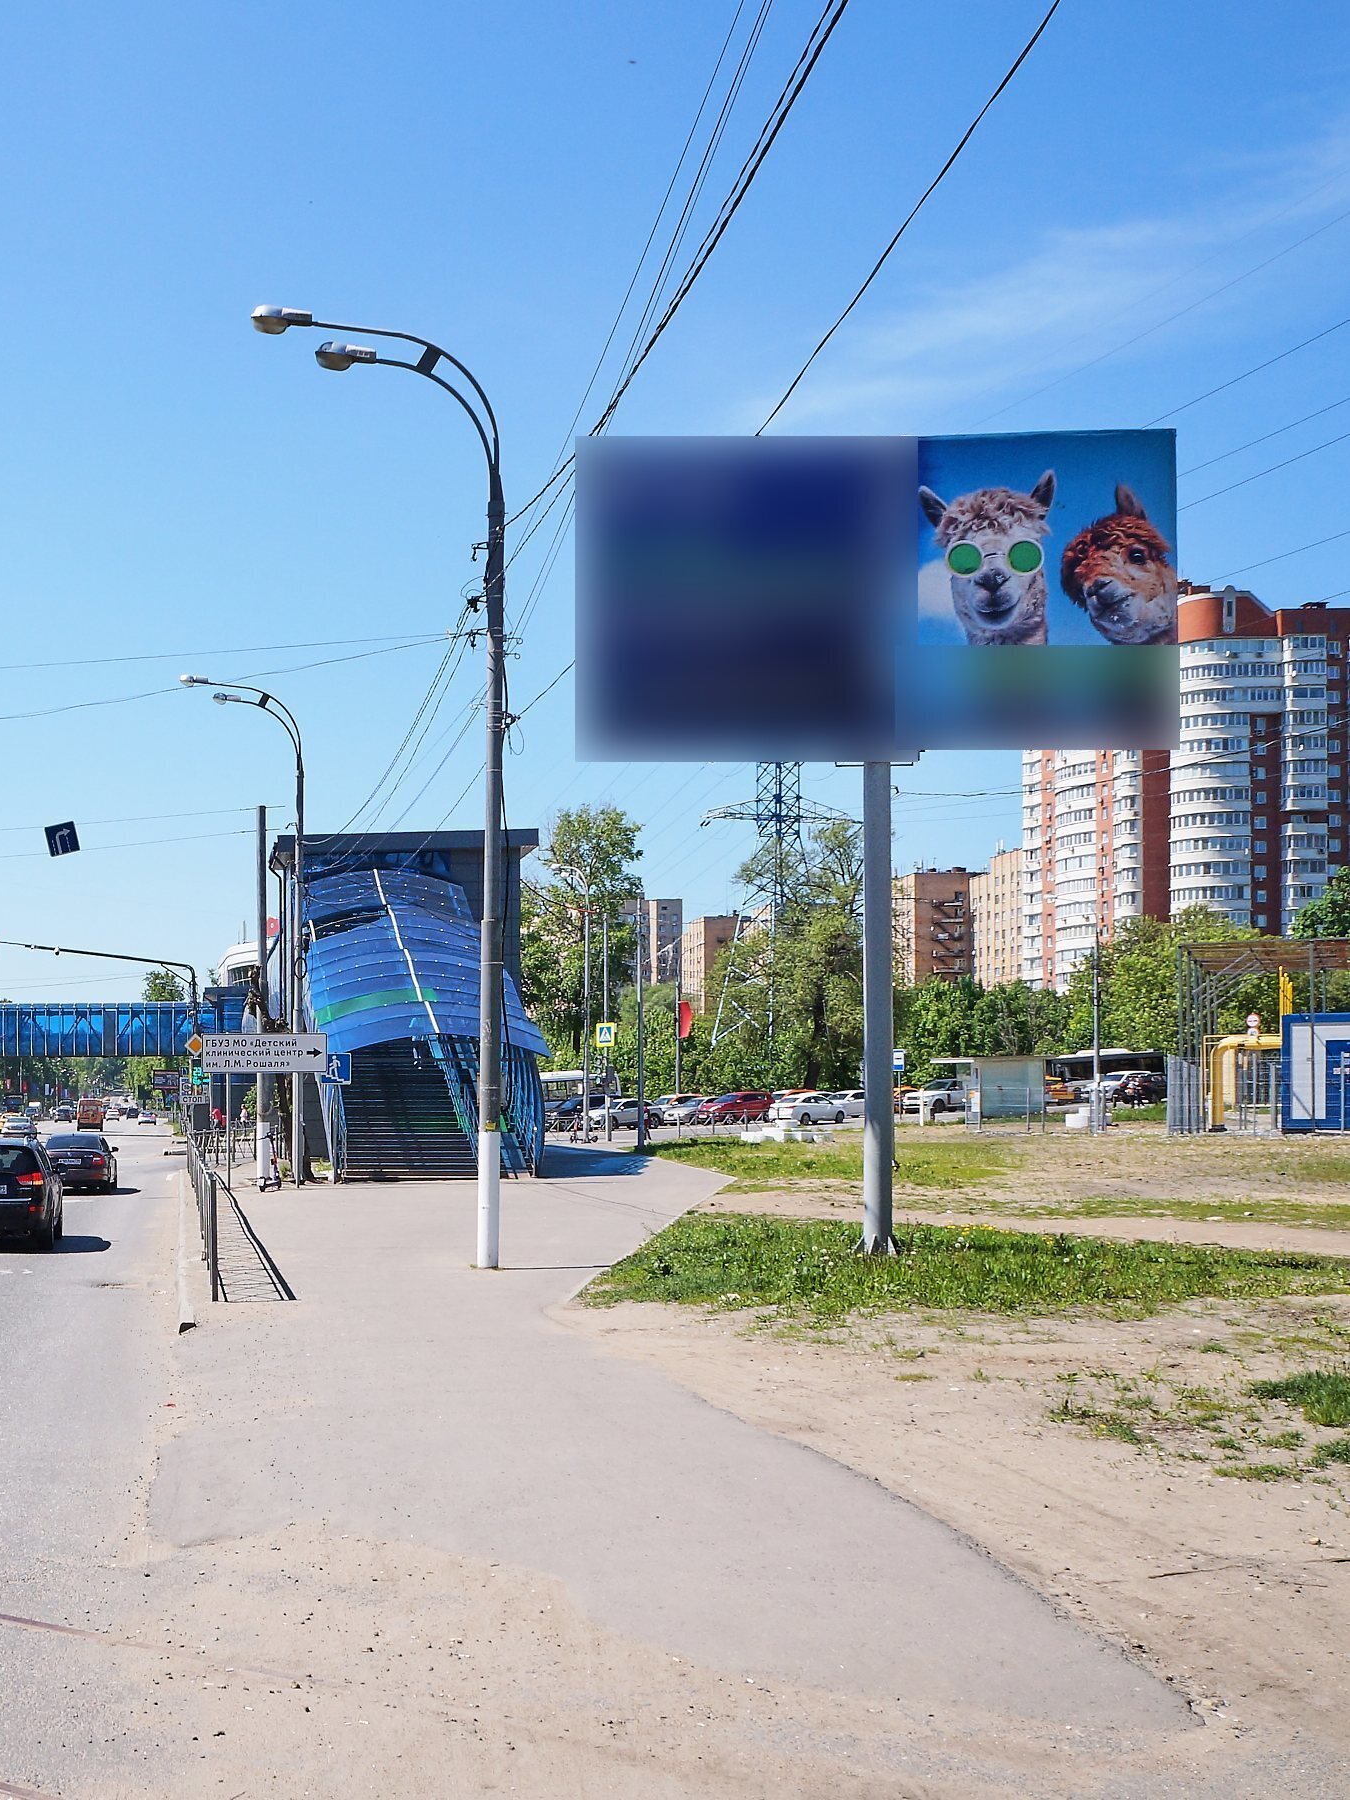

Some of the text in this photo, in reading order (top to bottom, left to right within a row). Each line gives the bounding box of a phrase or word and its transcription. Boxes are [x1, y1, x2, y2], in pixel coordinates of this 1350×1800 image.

[205, 1038, 298, 1049] ГБУЗ МО «Детский
[205, 1048, 304, 1058] клинический центр
[224, 1060, 245, 1068] Л.М.
[247, 1060, 290, 1068] Рошаля»
